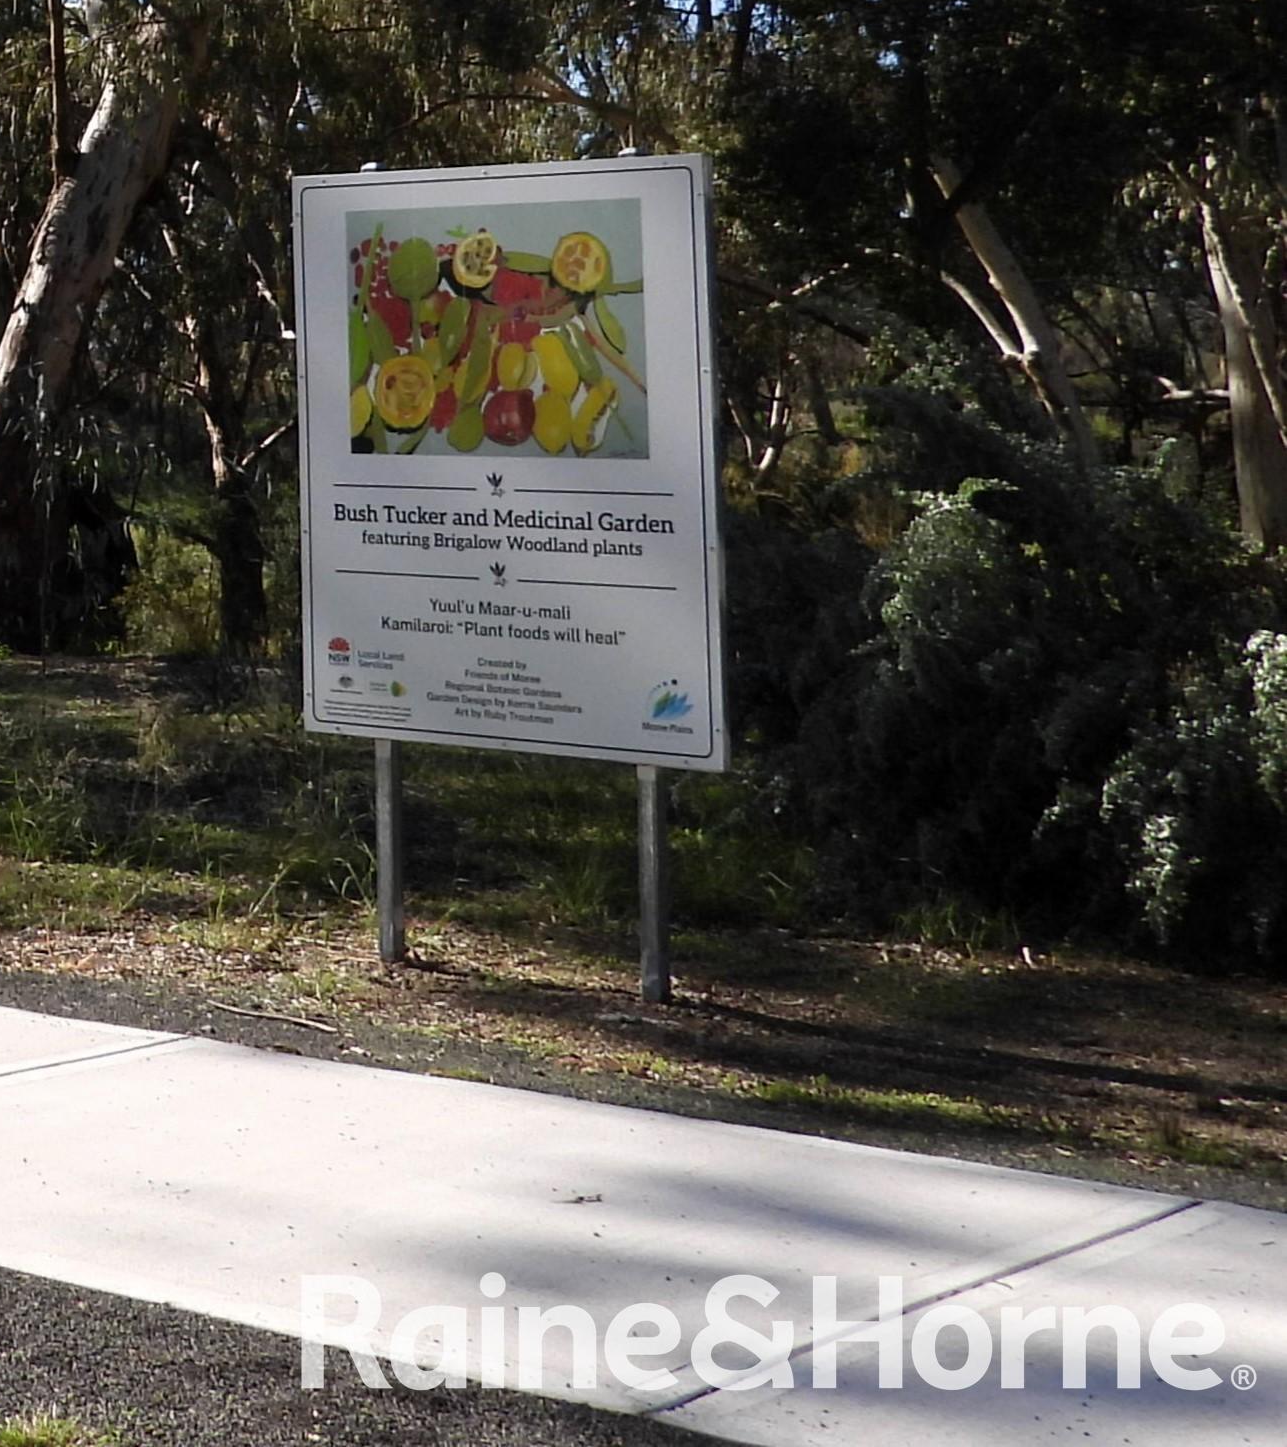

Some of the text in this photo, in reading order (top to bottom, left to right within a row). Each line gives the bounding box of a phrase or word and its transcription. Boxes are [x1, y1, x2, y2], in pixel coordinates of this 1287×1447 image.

[334, 504, 674, 534] Bush Tucker and Medicinal Garden
[362, 530, 643, 557] featuring Brigalow Woodland plants
[429, 598, 571, 620] Yuul'u Maar-u-mali
[381, 616, 454, 634] Kamilaroi:
[508, 625, 550, 641] foods
[554, 628, 581, 643] will
[477, 657, 527, 670] Created by
[454, 707, 469, 717] Art
[471, 708, 482, 719] by
[494, 697, 505, 708] by
